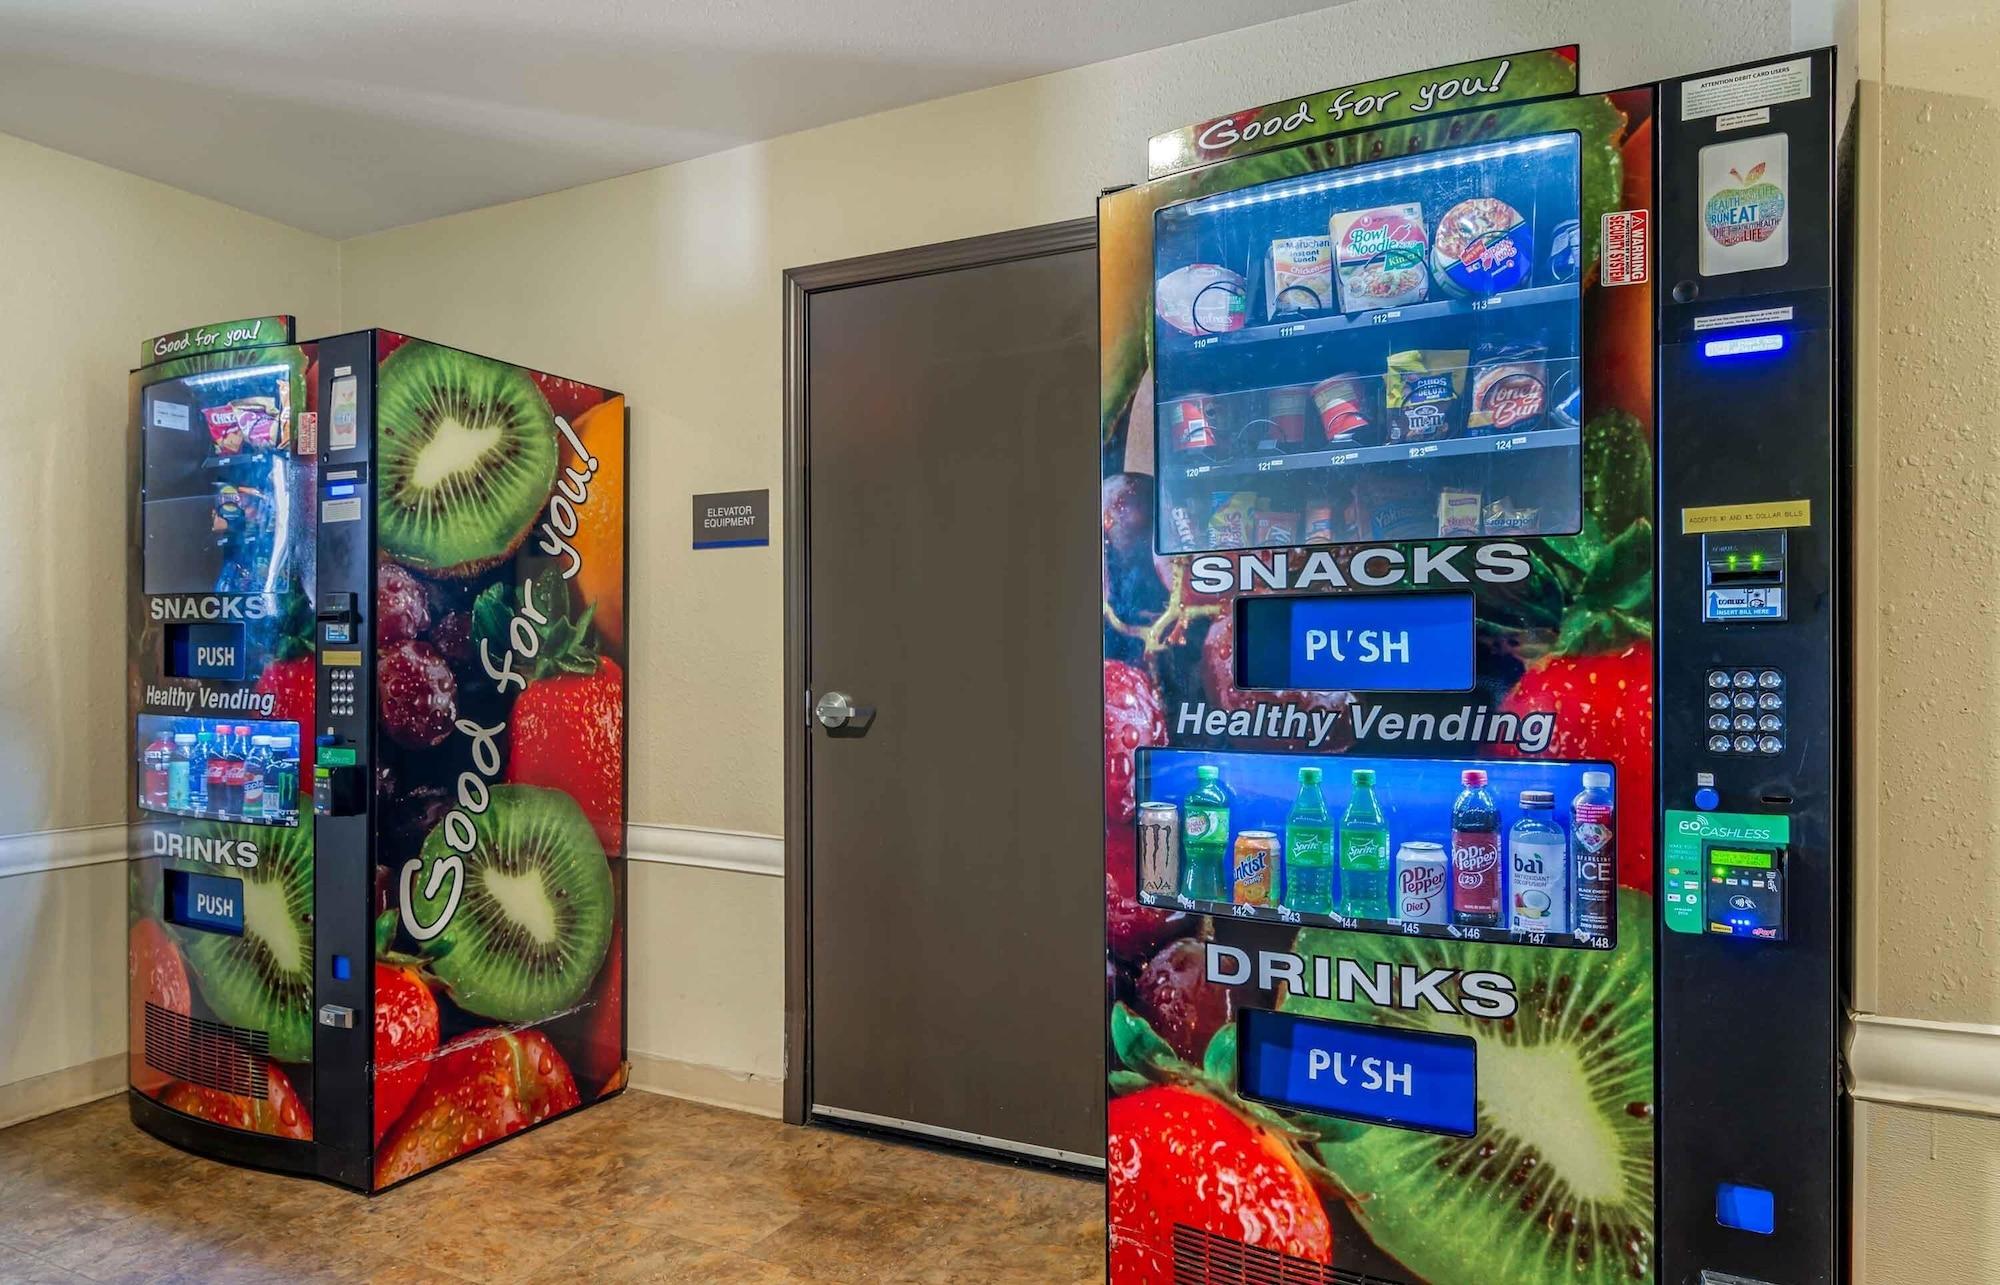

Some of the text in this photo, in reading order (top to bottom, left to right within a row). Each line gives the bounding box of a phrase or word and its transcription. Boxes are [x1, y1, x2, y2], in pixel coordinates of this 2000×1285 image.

[1701, 66, 1790, 89] ATTENTION DEBIT CARD USERS
[1197, 60, 1511, 150] Good for you!
[1711, 204, 1758, 225] RUN EAT
[1351, 224, 1388, 244] Bowl
[1348, 239, 1397, 256] Noodle
[1609, 215, 1625, 282] SECURITY SYSTEM
[1631, 228, 1645, 280] WARNING
[1472, 301, 1488, 310] 113
[1373, 313, 1388, 324] 112
[154, 320, 262, 356] Good for you!
[1280, 327, 1293, 337] 111
[1193, 340, 1206, 348] 110
[1494, 400, 1540, 425] Bun
[1409, 447, 1425, 458] 123
[1496, 440, 1512, 450] 124
[1258, 461, 1271, 471] 121
[1331, 454, 1346, 464] 122
[1186, 468, 1199, 477] 120
[707, 505, 752, 517] ELEVATOR
[1784, 510, 1803, 518] BILLS
[704, 516, 756, 528] EQUIPMENT
[1190, 543, 1532, 594] SNACKS
[150, 595, 269, 620] SNACKS
[1306, 629, 1410, 664] PUSH
[197, 646, 235, 667] PUSH
[399, 415, 599, 941] Good for you!
[146, 684, 276, 716] Healthy Vending
[1176, 701, 1556, 753] Healthy Vending
[1680, 820, 1771, 840] GO CASHLESS
[153, 829, 260, 868] DRINKS
[1293, 840, 1320, 851] Sprite
[1349, 844, 1376, 856] Sprite
[1467, 846, 1486, 857] Dr
[1233, 851, 1266, 881] nkist
[1458, 849, 1495, 871] Pepper
[1514, 853, 1544, 874] bai
[1414, 865, 1435, 879] Dr
[1464, 875, 1474, 885] 23
[1577, 862, 1611, 881] ICE
[1402, 869, 1444, 896] Pepper
[197, 892, 234, 918] PUSH
[1232, 906, 1247, 916] 142
[1406, 900, 1424, 912] Diet
[1341, 917, 1358, 929] 144
[1402, 922, 1420, 934] 145
[1462, 927, 1480, 939] 146
[1528, 933, 1546, 944] 147
[1590, 938, 1609, 948] 148
[1205, 943, 1519, 1019] DRINKS
[1308, 1048, 1413, 1097] PUSH
